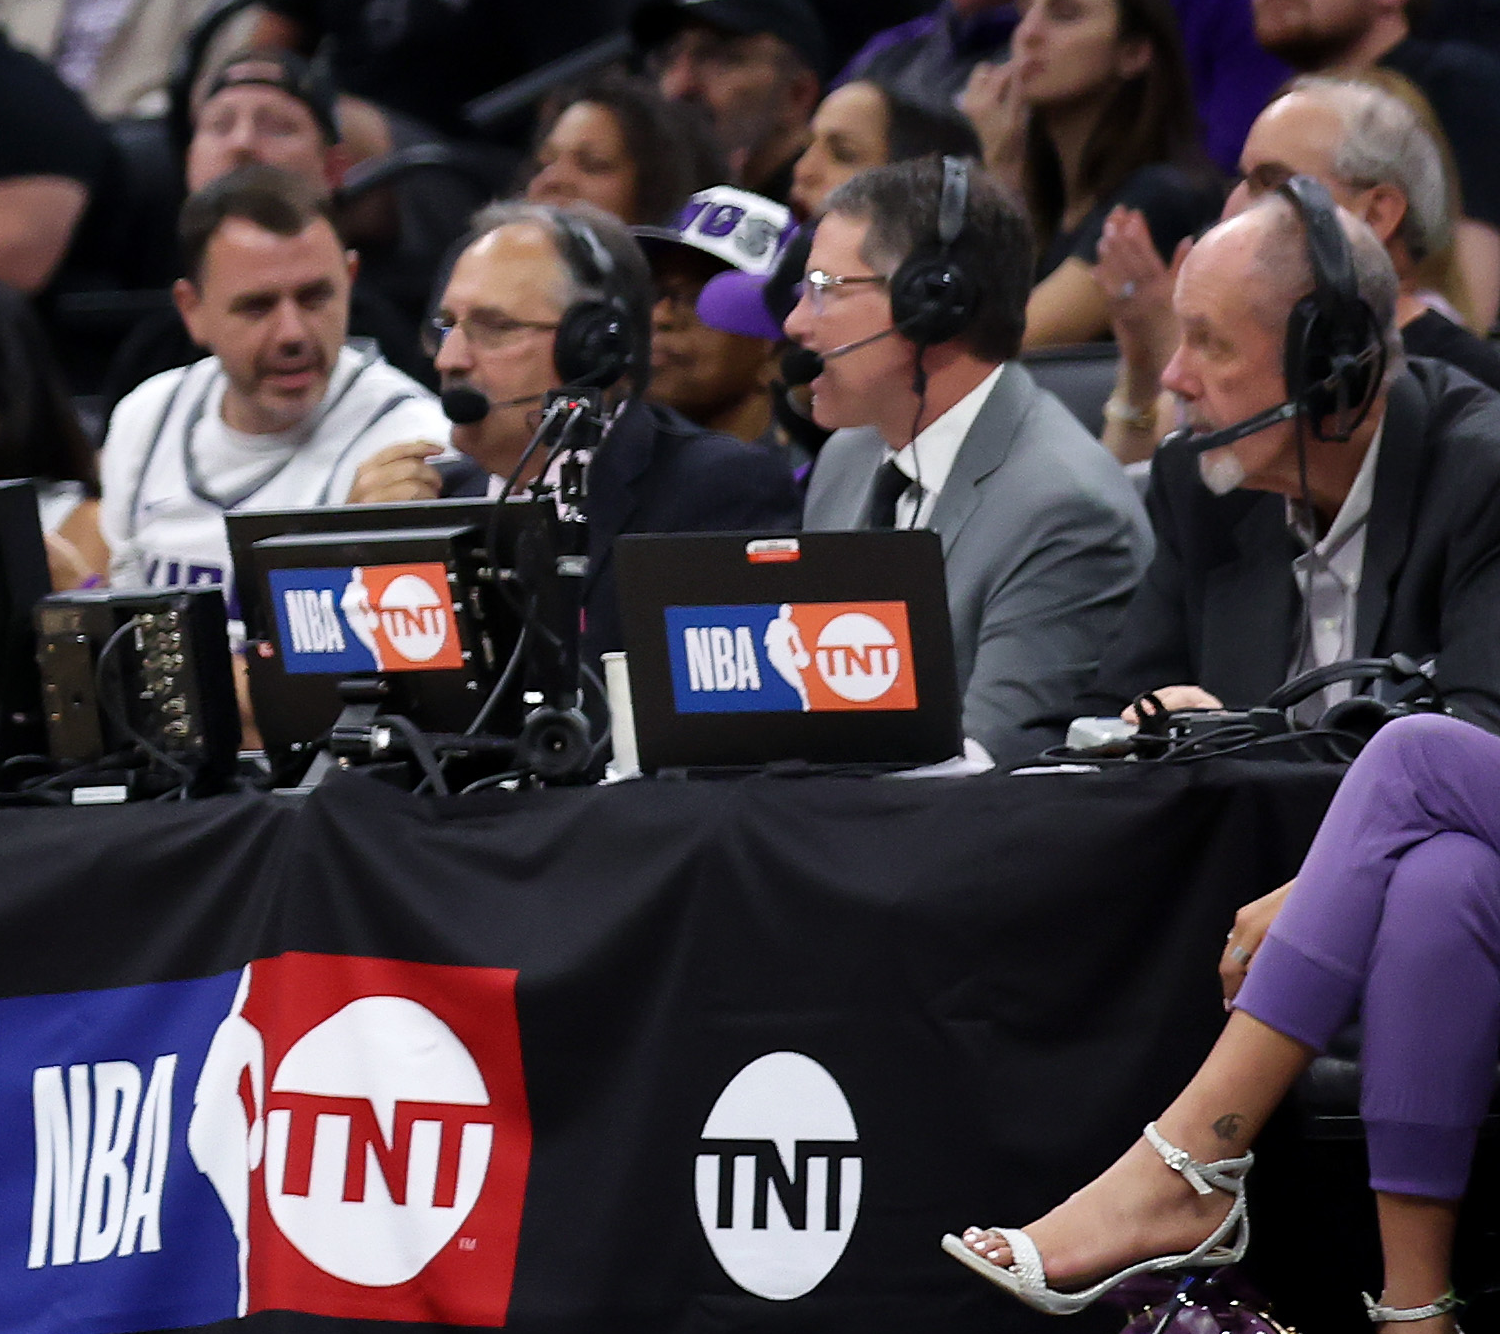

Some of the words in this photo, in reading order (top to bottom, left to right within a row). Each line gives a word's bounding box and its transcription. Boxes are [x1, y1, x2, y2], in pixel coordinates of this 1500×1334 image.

[284, 588, 344, 654] NBA
[379, 606, 447, 640] TNT
[684, 626, 761, 692] NBA
[816, 645, 900, 678] TNT
[28, 1054, 178, 1269] NBA
[267, 1091, 495, 1208] TNT
[695, 1139, 863, 1231] TNT
